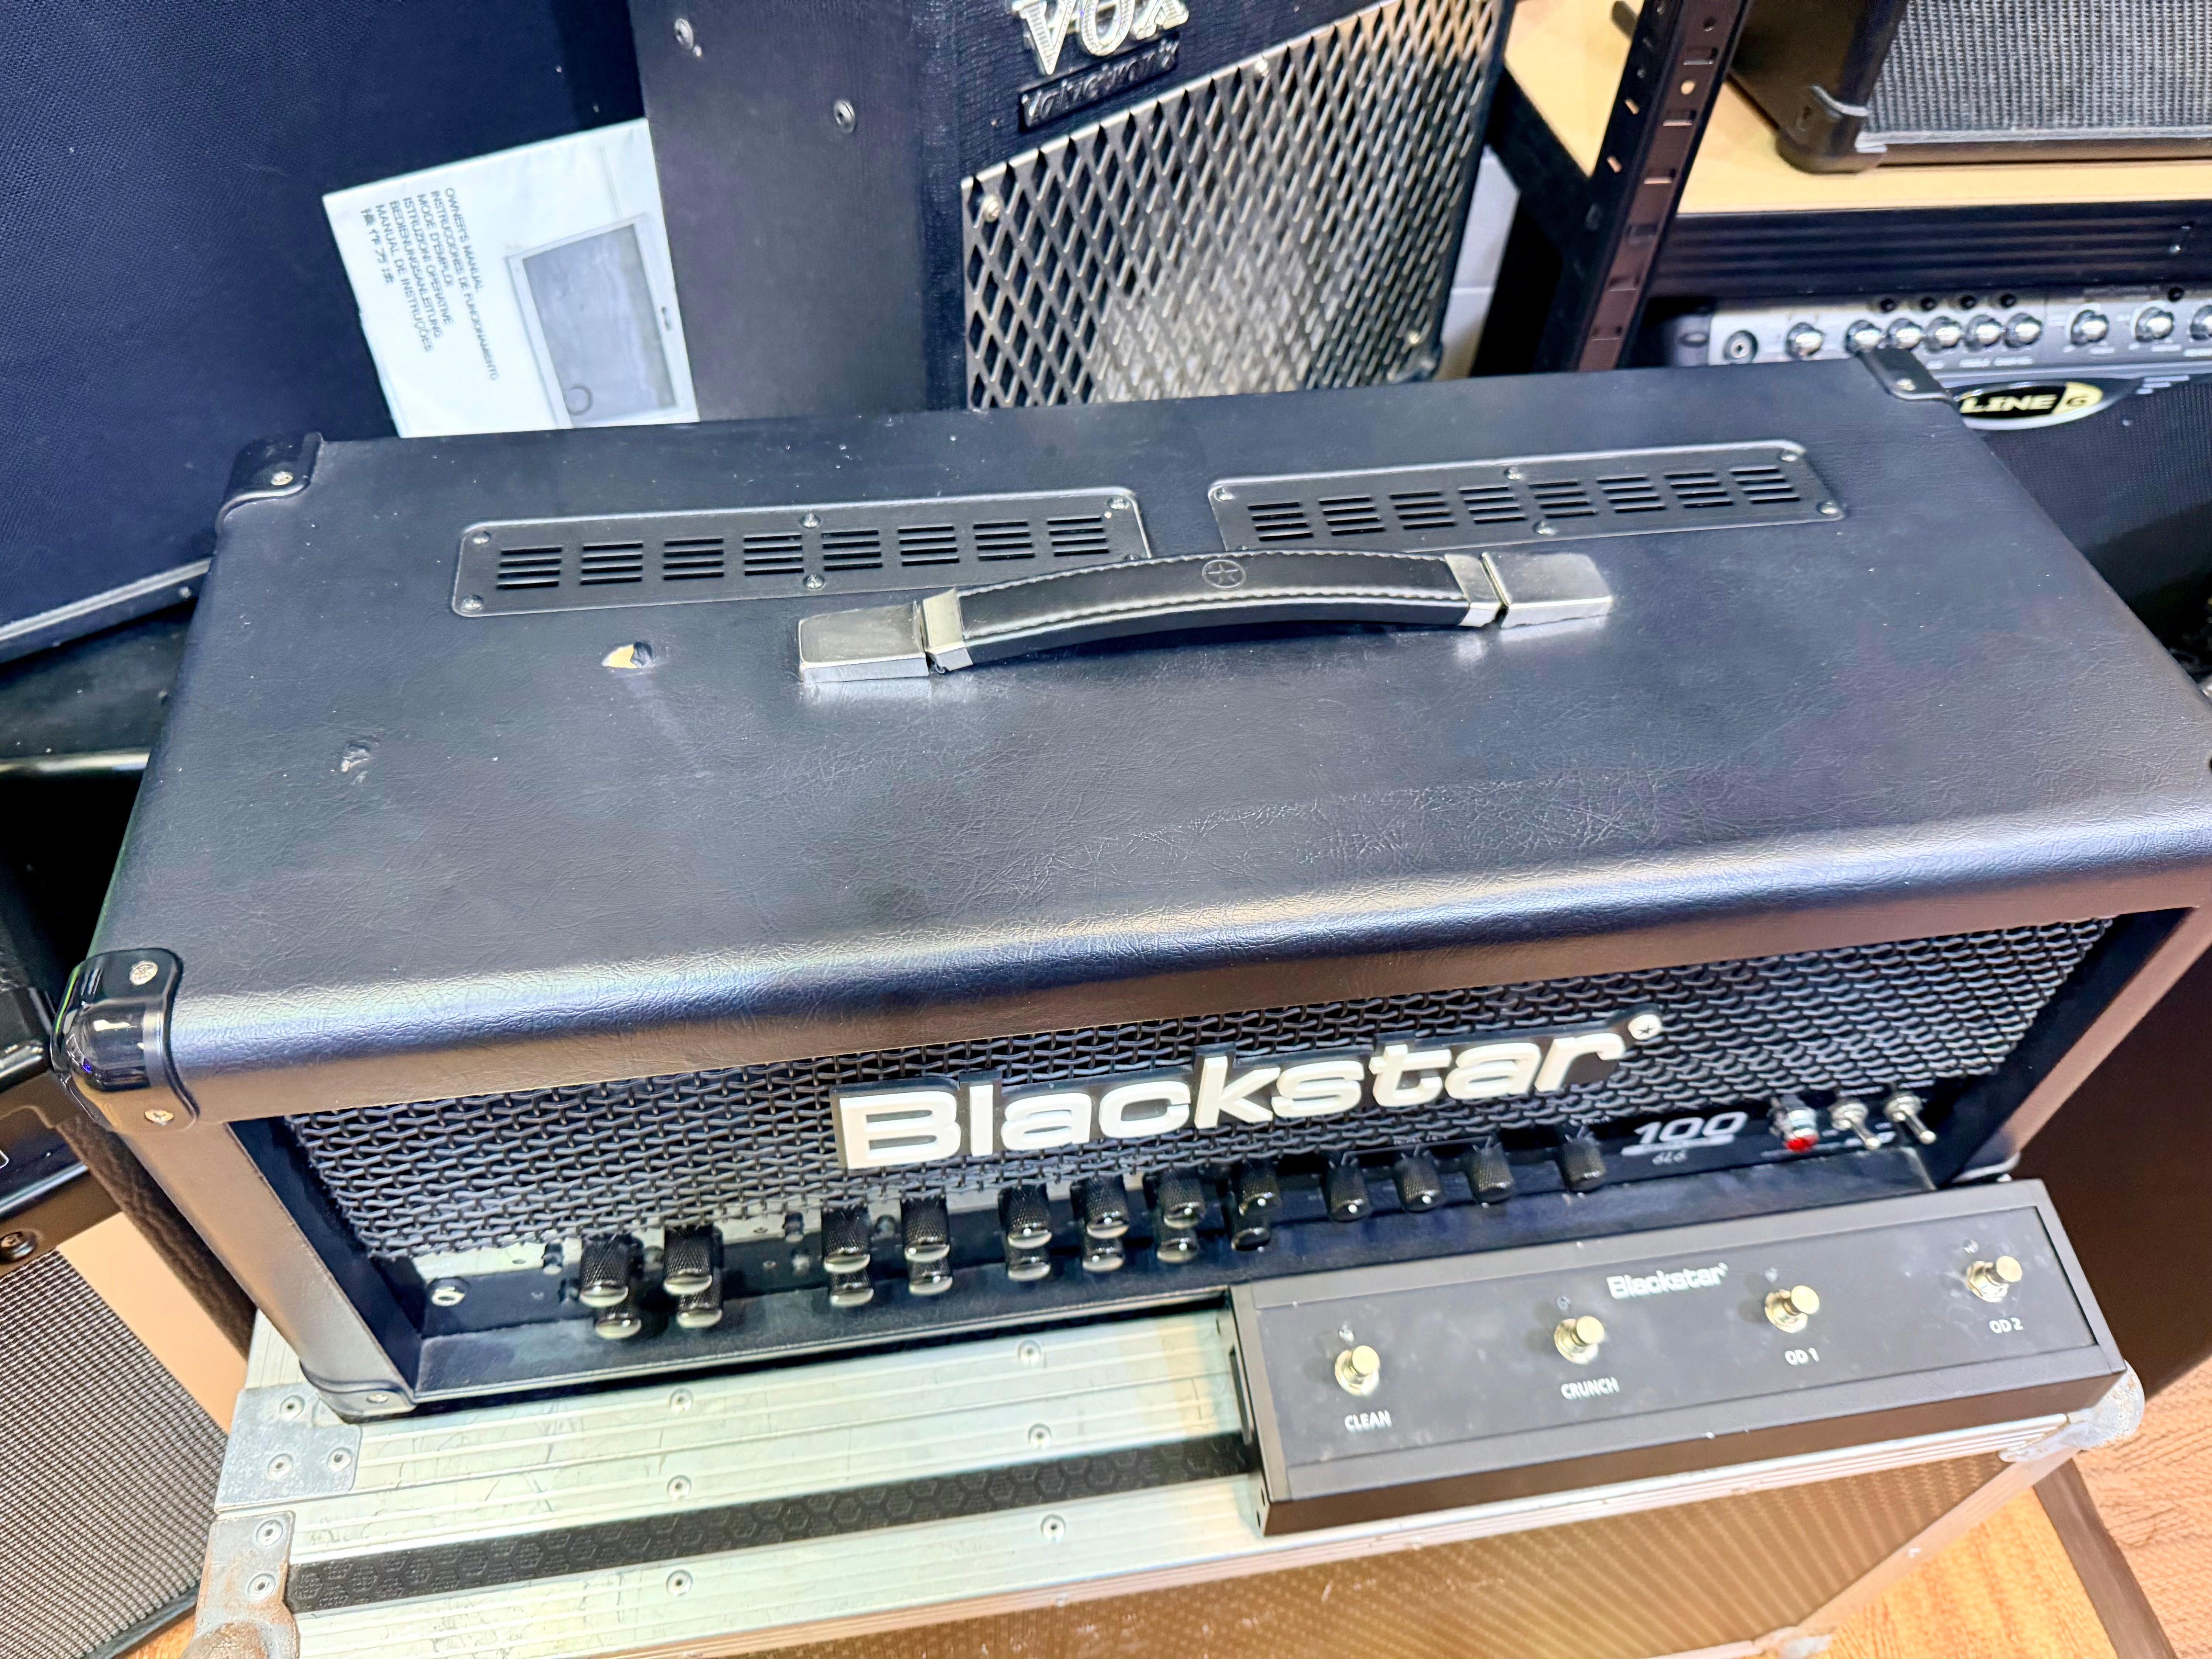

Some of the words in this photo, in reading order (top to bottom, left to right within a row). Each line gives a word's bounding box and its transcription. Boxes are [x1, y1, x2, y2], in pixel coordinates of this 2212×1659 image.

[418, 194, 436, 229] MODE
[376, 205, 399, 254] MANUAL
[394, 259, 407, 273] DE
[390, 201, 443, 337] BEDIENUNGSANLEITUNG
[459, 277, 470, 289] DE
[464, 246, 484, 292] MANUAL
[426, 264, 452, 324] OPERATIVE
[1960, 393, 2059, 414] LINE
[839, 1029, 1626, 1170] Blackstar
[1633, 1111, 1749, 1144] 100
[1606, 1264, 1723, 1300] Blackstar
[1989, 1319, 2011, 1334] OD
[2010, 1317, 2024, 1331] 2
[1784, 1349, 1808, 1366] OD
[1809, 1347, 1819, 1363] 1
[1560, 1376, 1620, 1400] CRUNCH
[1344, 1410, 1392, 1433] CLEAN
